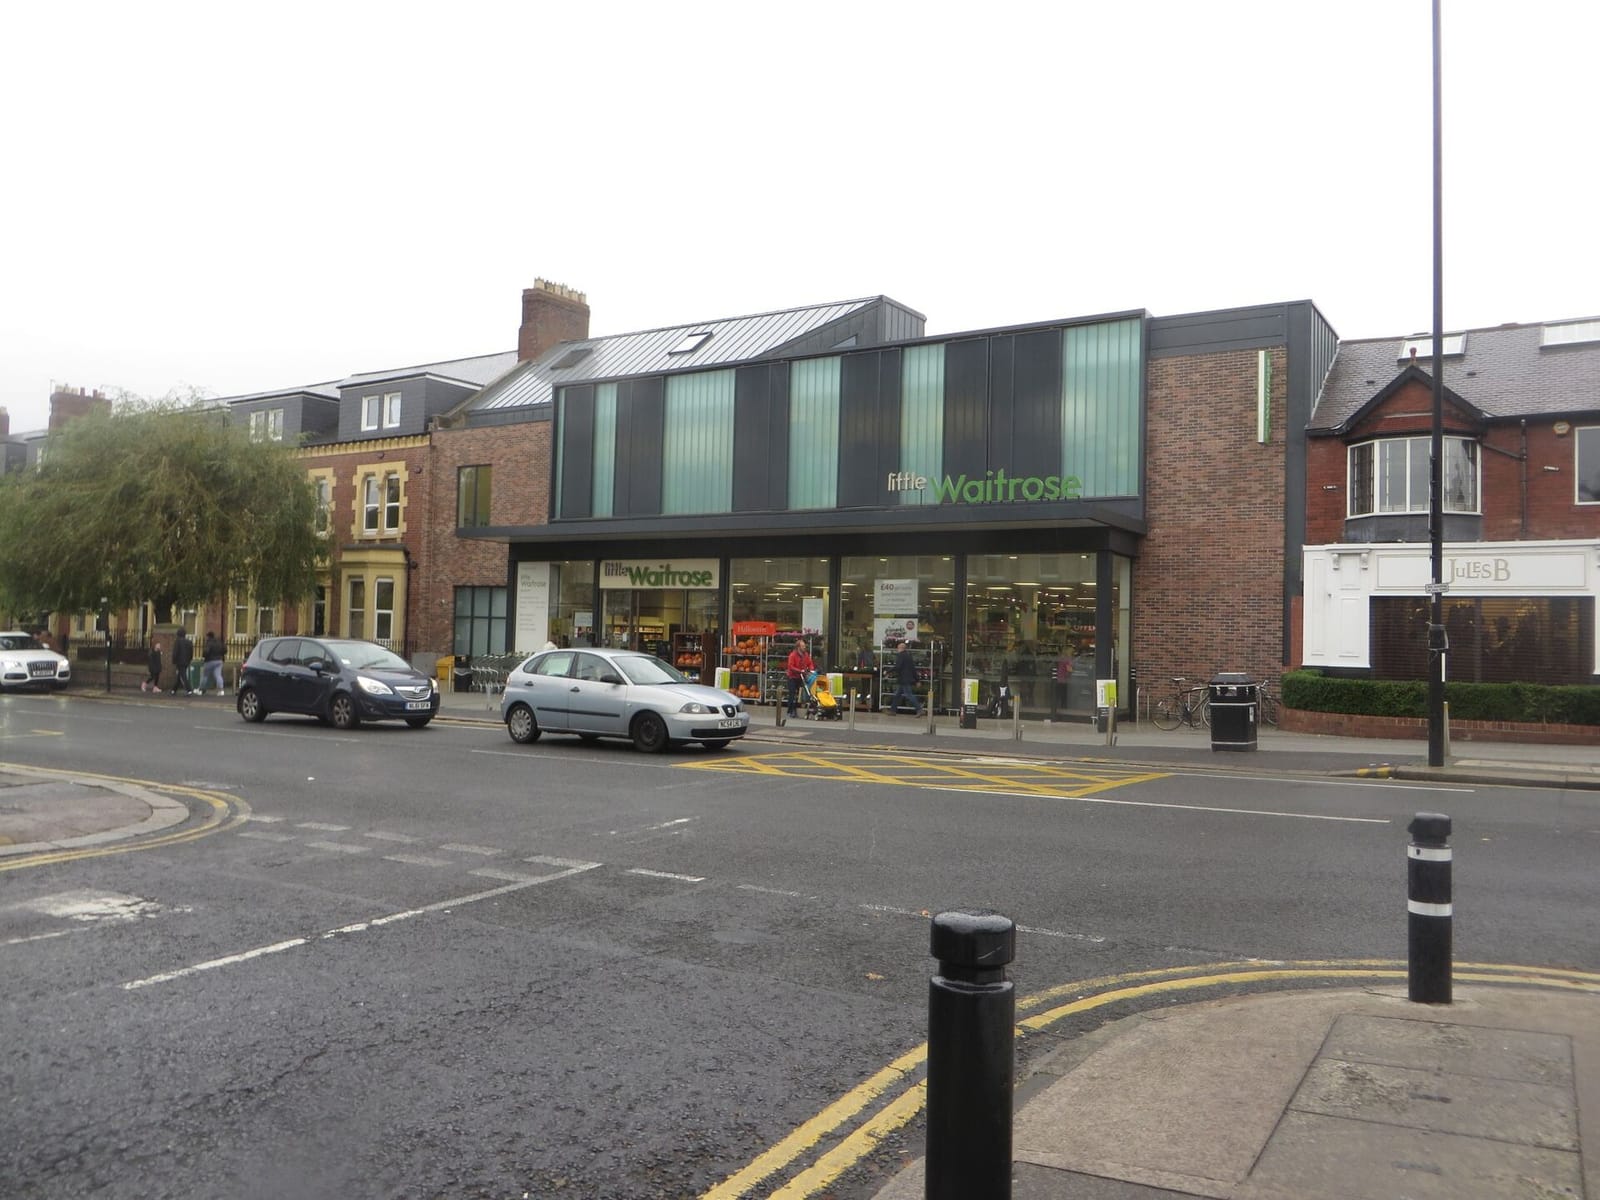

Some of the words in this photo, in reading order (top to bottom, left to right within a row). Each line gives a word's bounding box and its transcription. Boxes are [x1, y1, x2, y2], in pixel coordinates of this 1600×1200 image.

[887, 472, 927, 491] little
[930, 468, 1082, 504] Waitrose
[604, 562, 628, 577] little
[628, 563, 713, 587] Waitrose
[1493, 558, 1511, 582] B
[880, 583, 895, 591] £40
